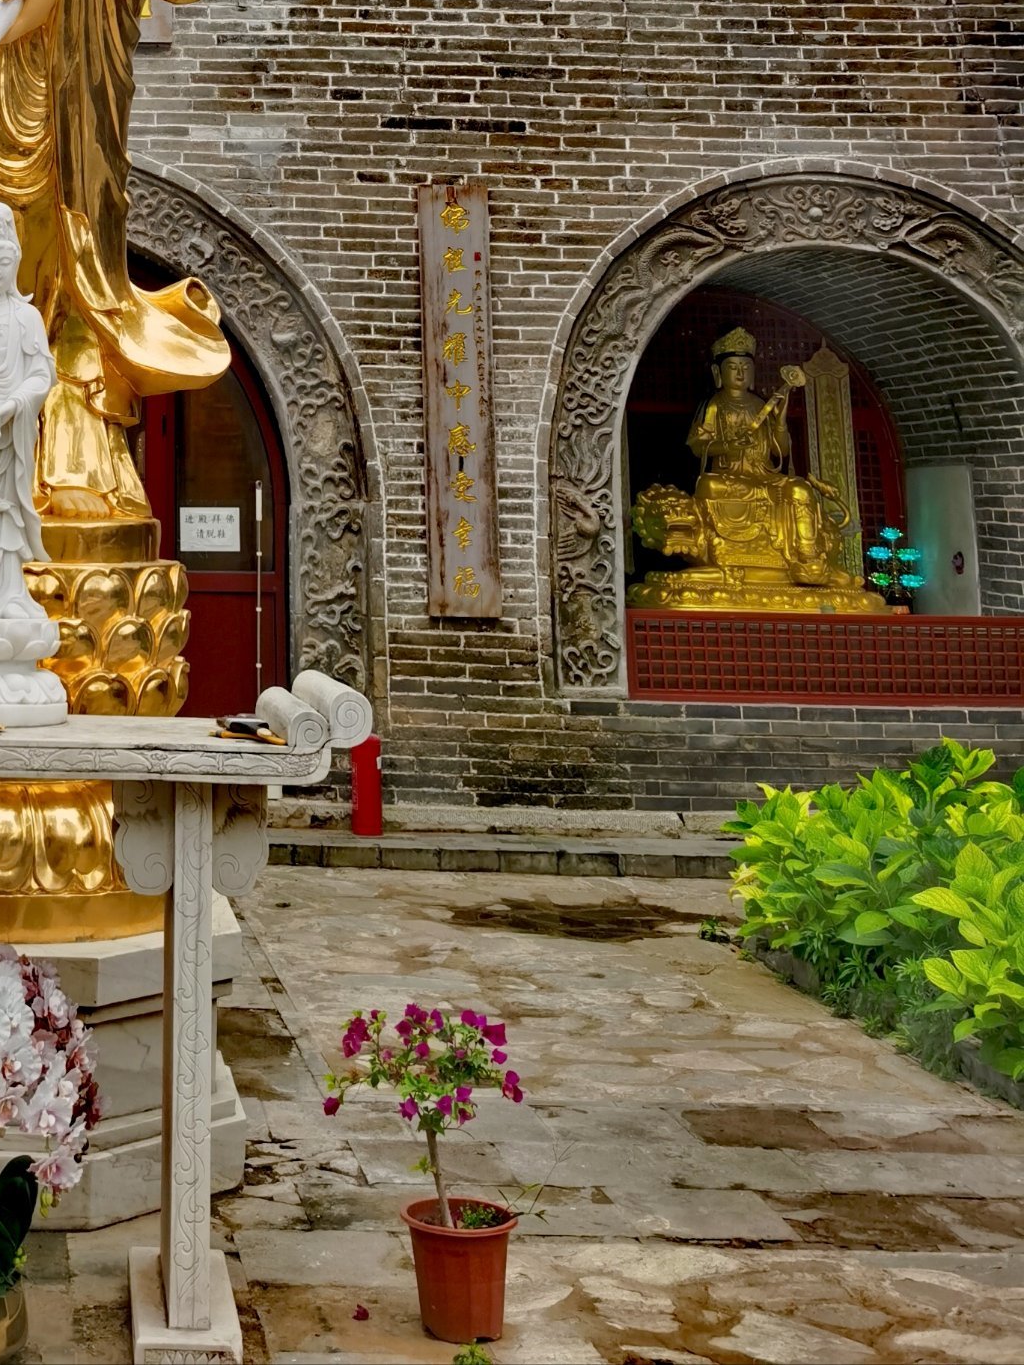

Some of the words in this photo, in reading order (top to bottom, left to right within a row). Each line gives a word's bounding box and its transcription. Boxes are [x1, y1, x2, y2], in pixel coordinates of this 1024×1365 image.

[184, 513, 235, 525] 进殿拜佛
[195, 528, 226, 539] 请脱鞋
